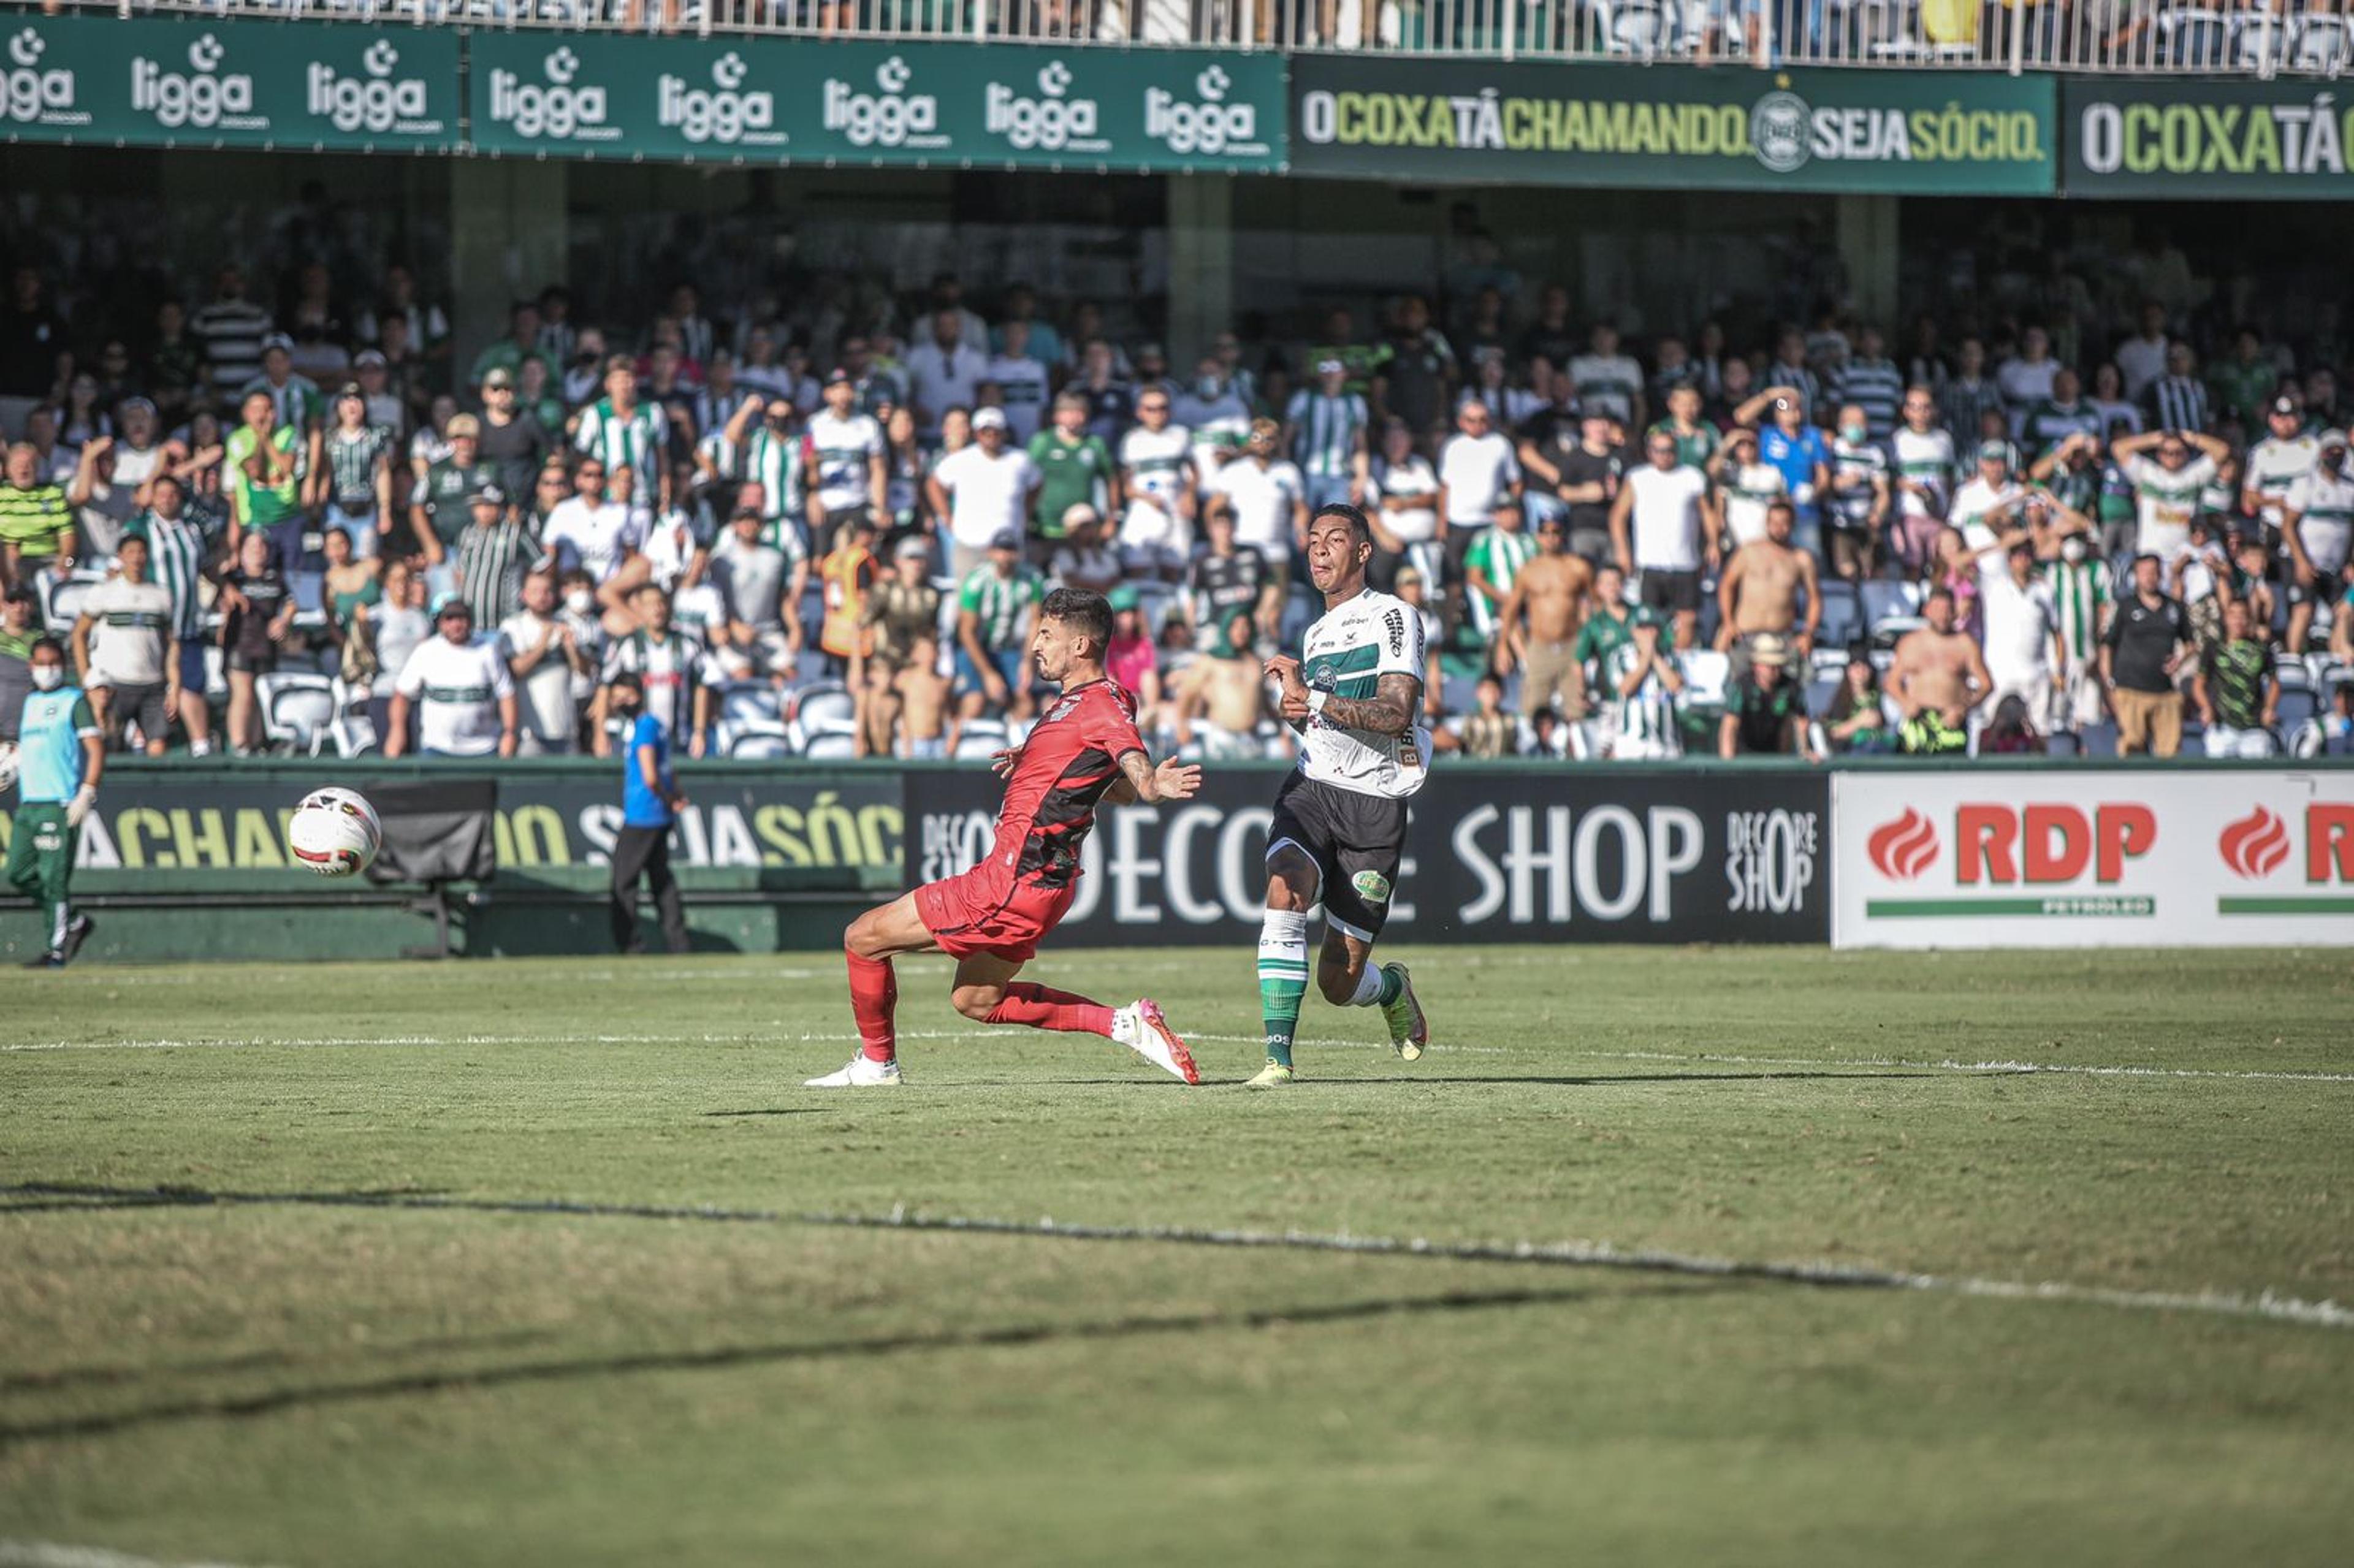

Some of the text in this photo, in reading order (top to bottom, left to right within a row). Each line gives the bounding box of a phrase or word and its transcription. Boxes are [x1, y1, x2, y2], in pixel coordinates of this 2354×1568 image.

[0, 69, 74, 121] ga
[132, 57, 252, 126] ligga
[308, 61, 426, 131] ligga
[490, 67, 606, 138] ligga
[658, 74, 772, 142] ligga
[824, 78, 936, 146] ligga
[986, 82, 1097, 150] ligga
[1145, 86, 1255, 153] ligga
[1452, 804, 1704, 923] SHOP
[1727, 809, 1818, 863] DECORE
[1956, 802, 2157, 885] RDP
[1725, 847, 1813, 913] SHOP
